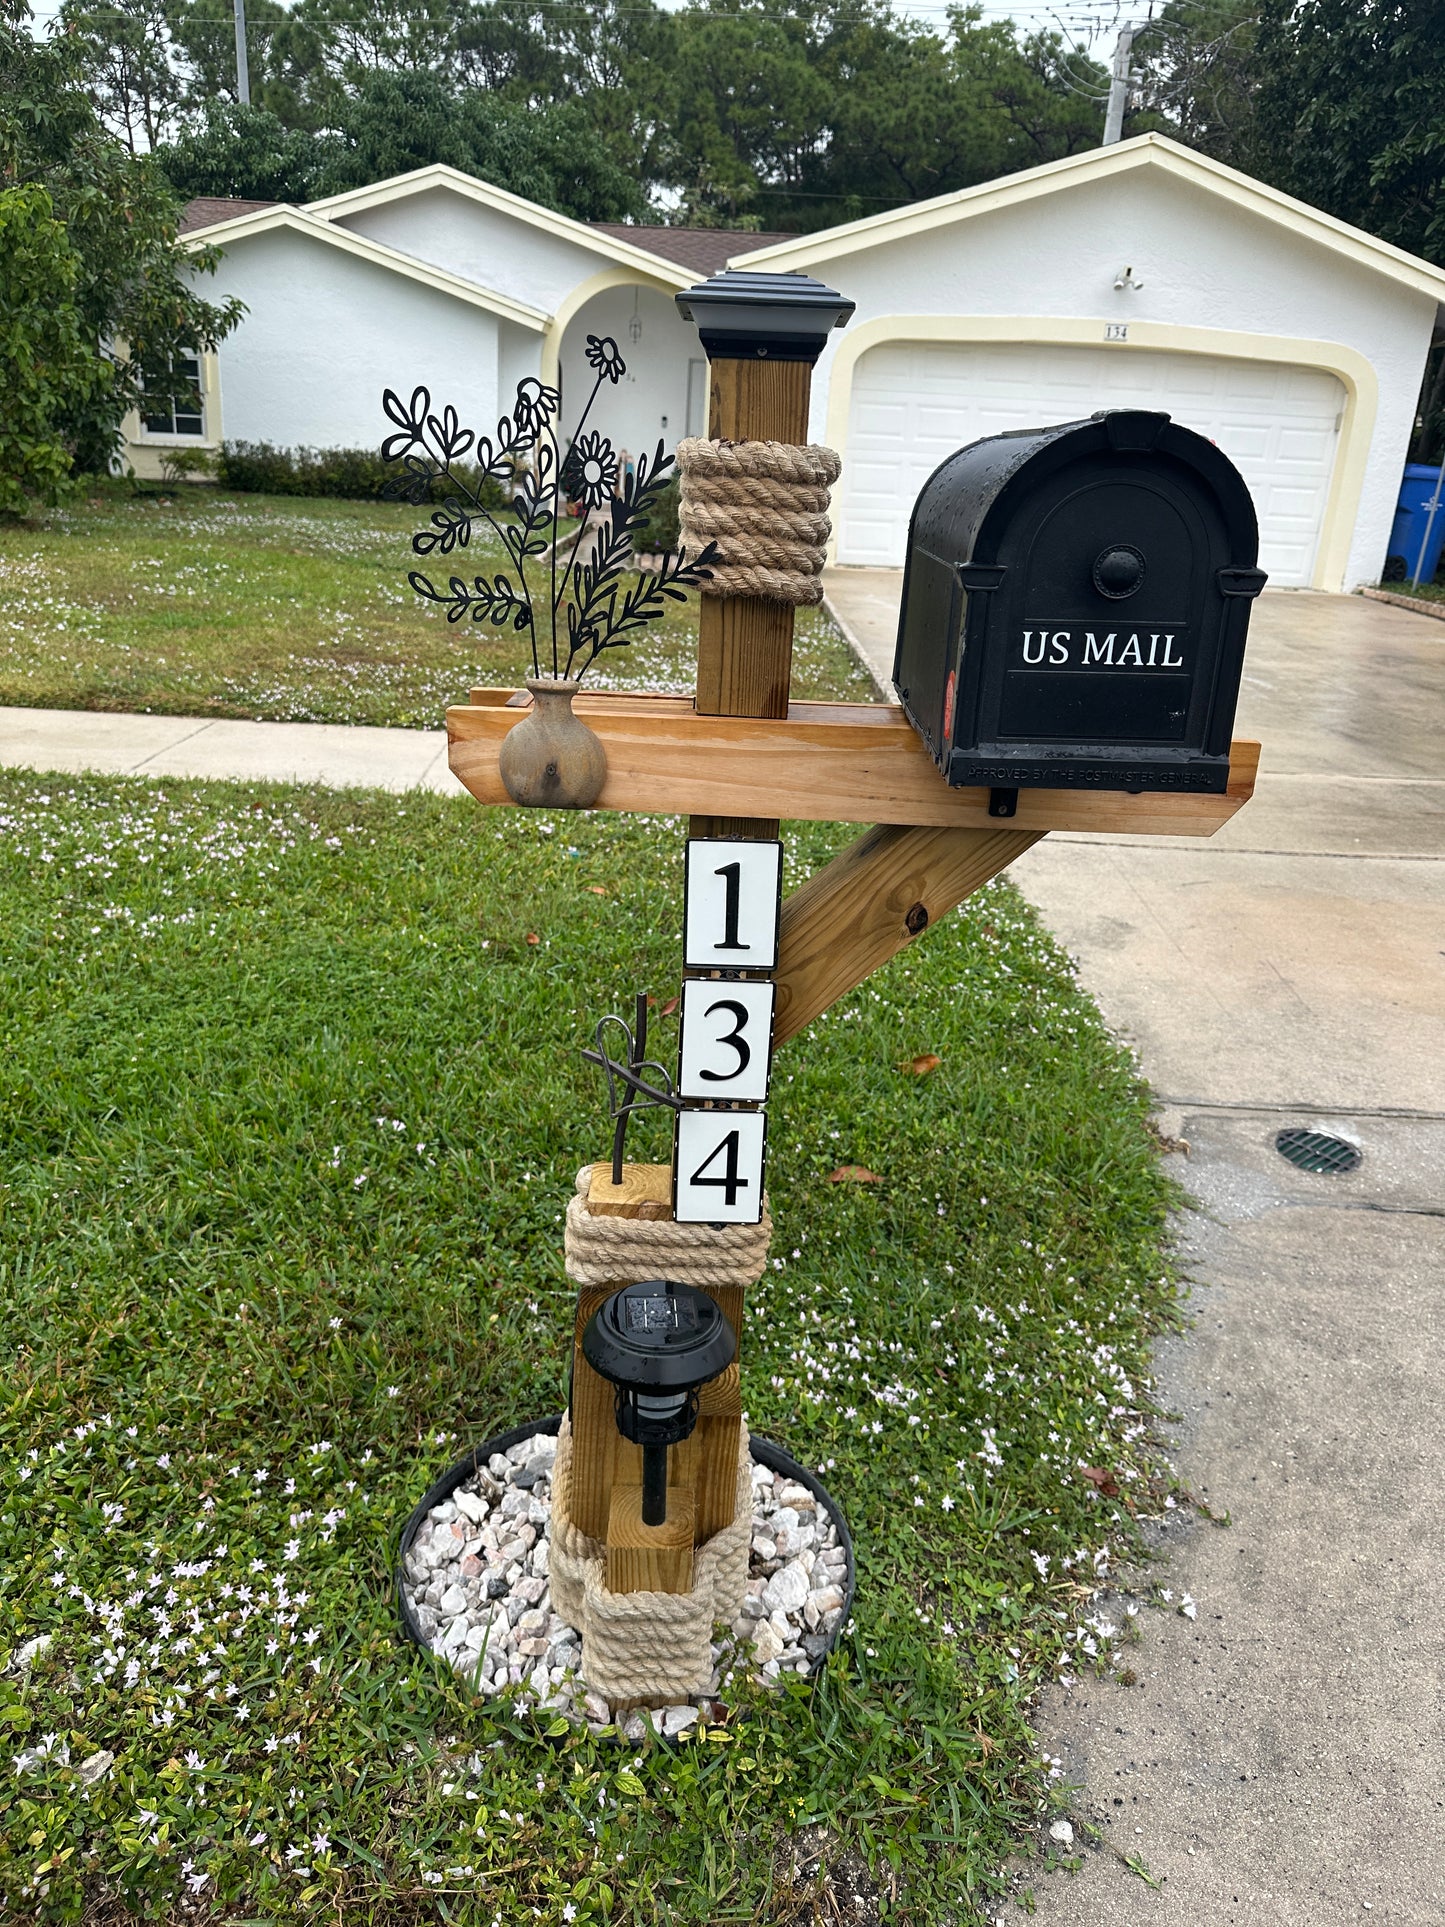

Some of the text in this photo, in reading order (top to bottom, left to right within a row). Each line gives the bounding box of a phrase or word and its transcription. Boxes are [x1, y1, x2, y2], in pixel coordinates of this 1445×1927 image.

[1107, 326, 1127, 338] 134
[1022, 631, 1183, 667] US MAIL
[967, 764, 1215, 786] APPROVED BY THE POSTMASTER GENERAL
